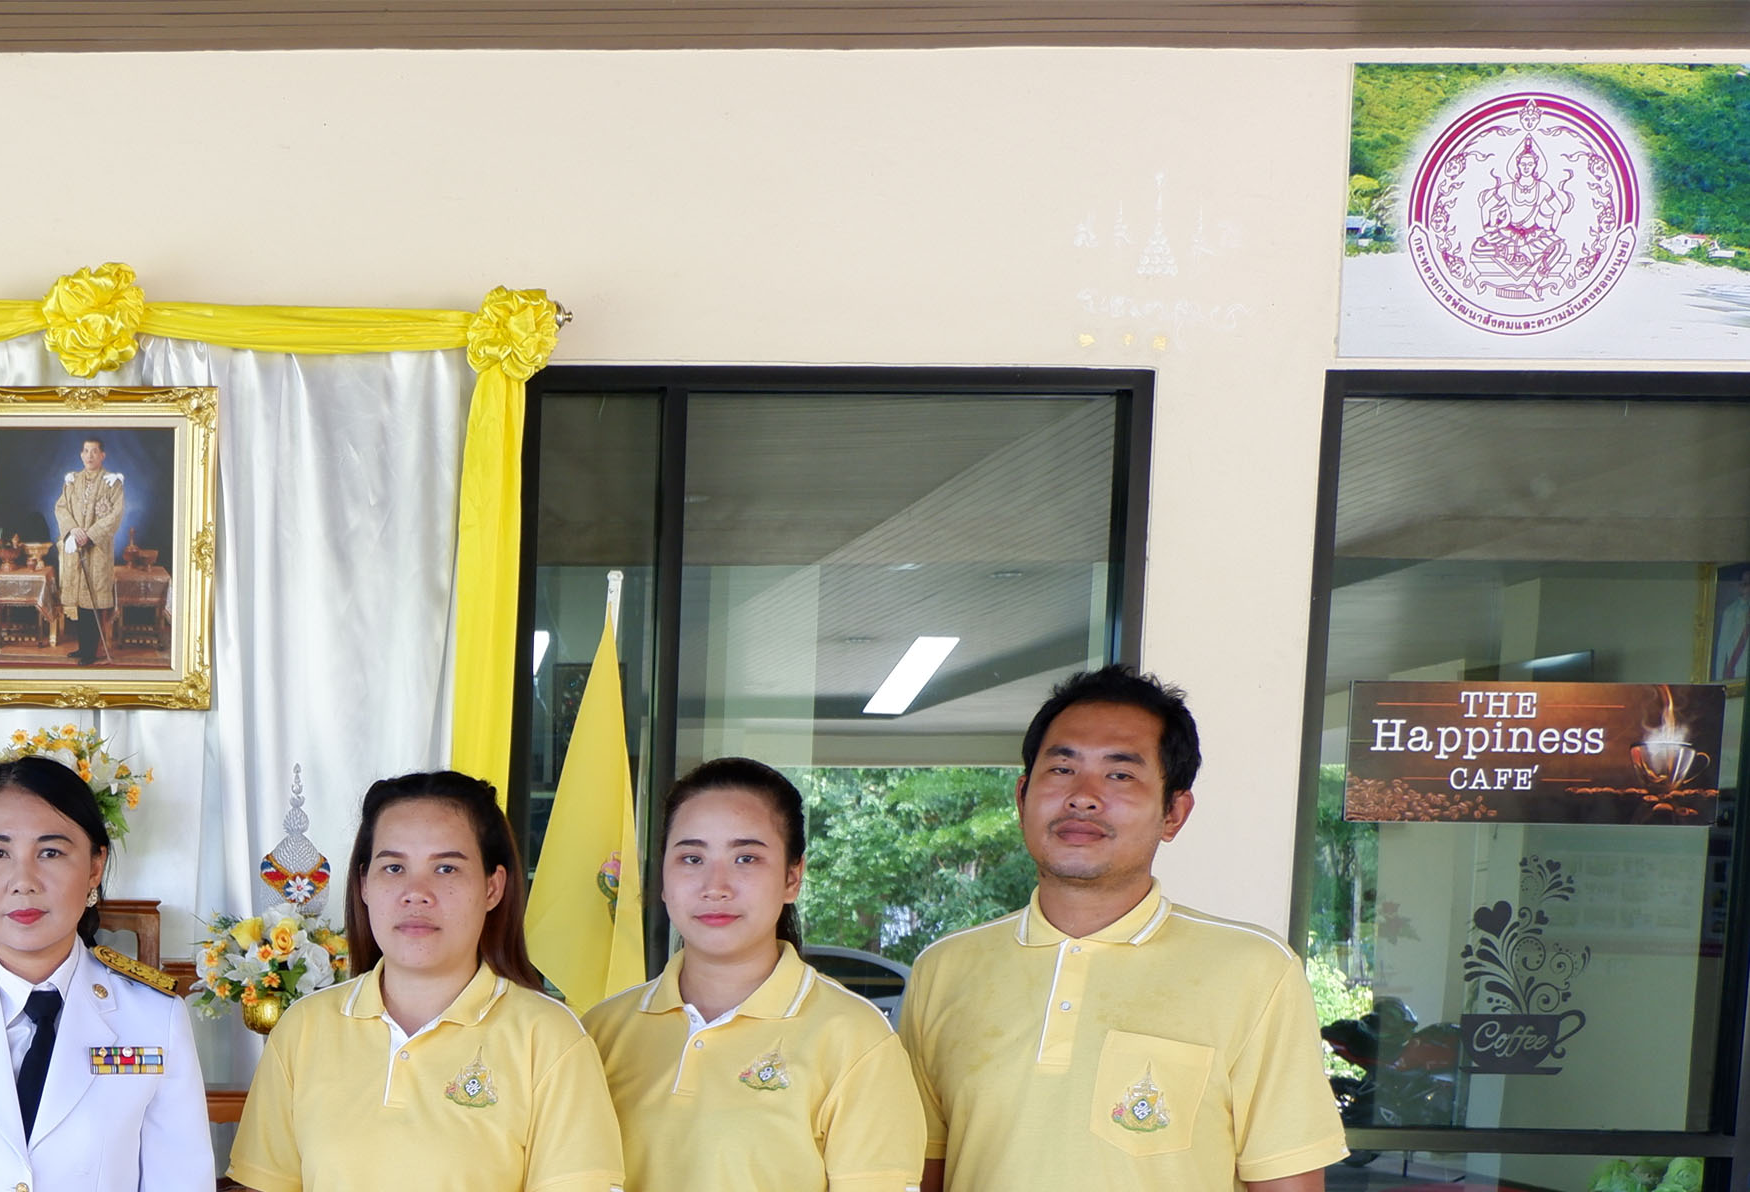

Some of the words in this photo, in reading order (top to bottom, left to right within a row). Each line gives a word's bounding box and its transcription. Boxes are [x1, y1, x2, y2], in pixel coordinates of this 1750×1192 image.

[1460, 691, 1538, 719] THE
[1370, 719, 1605, 760] Happiness
[1472, 1020, 1549, 1058] Coffee
